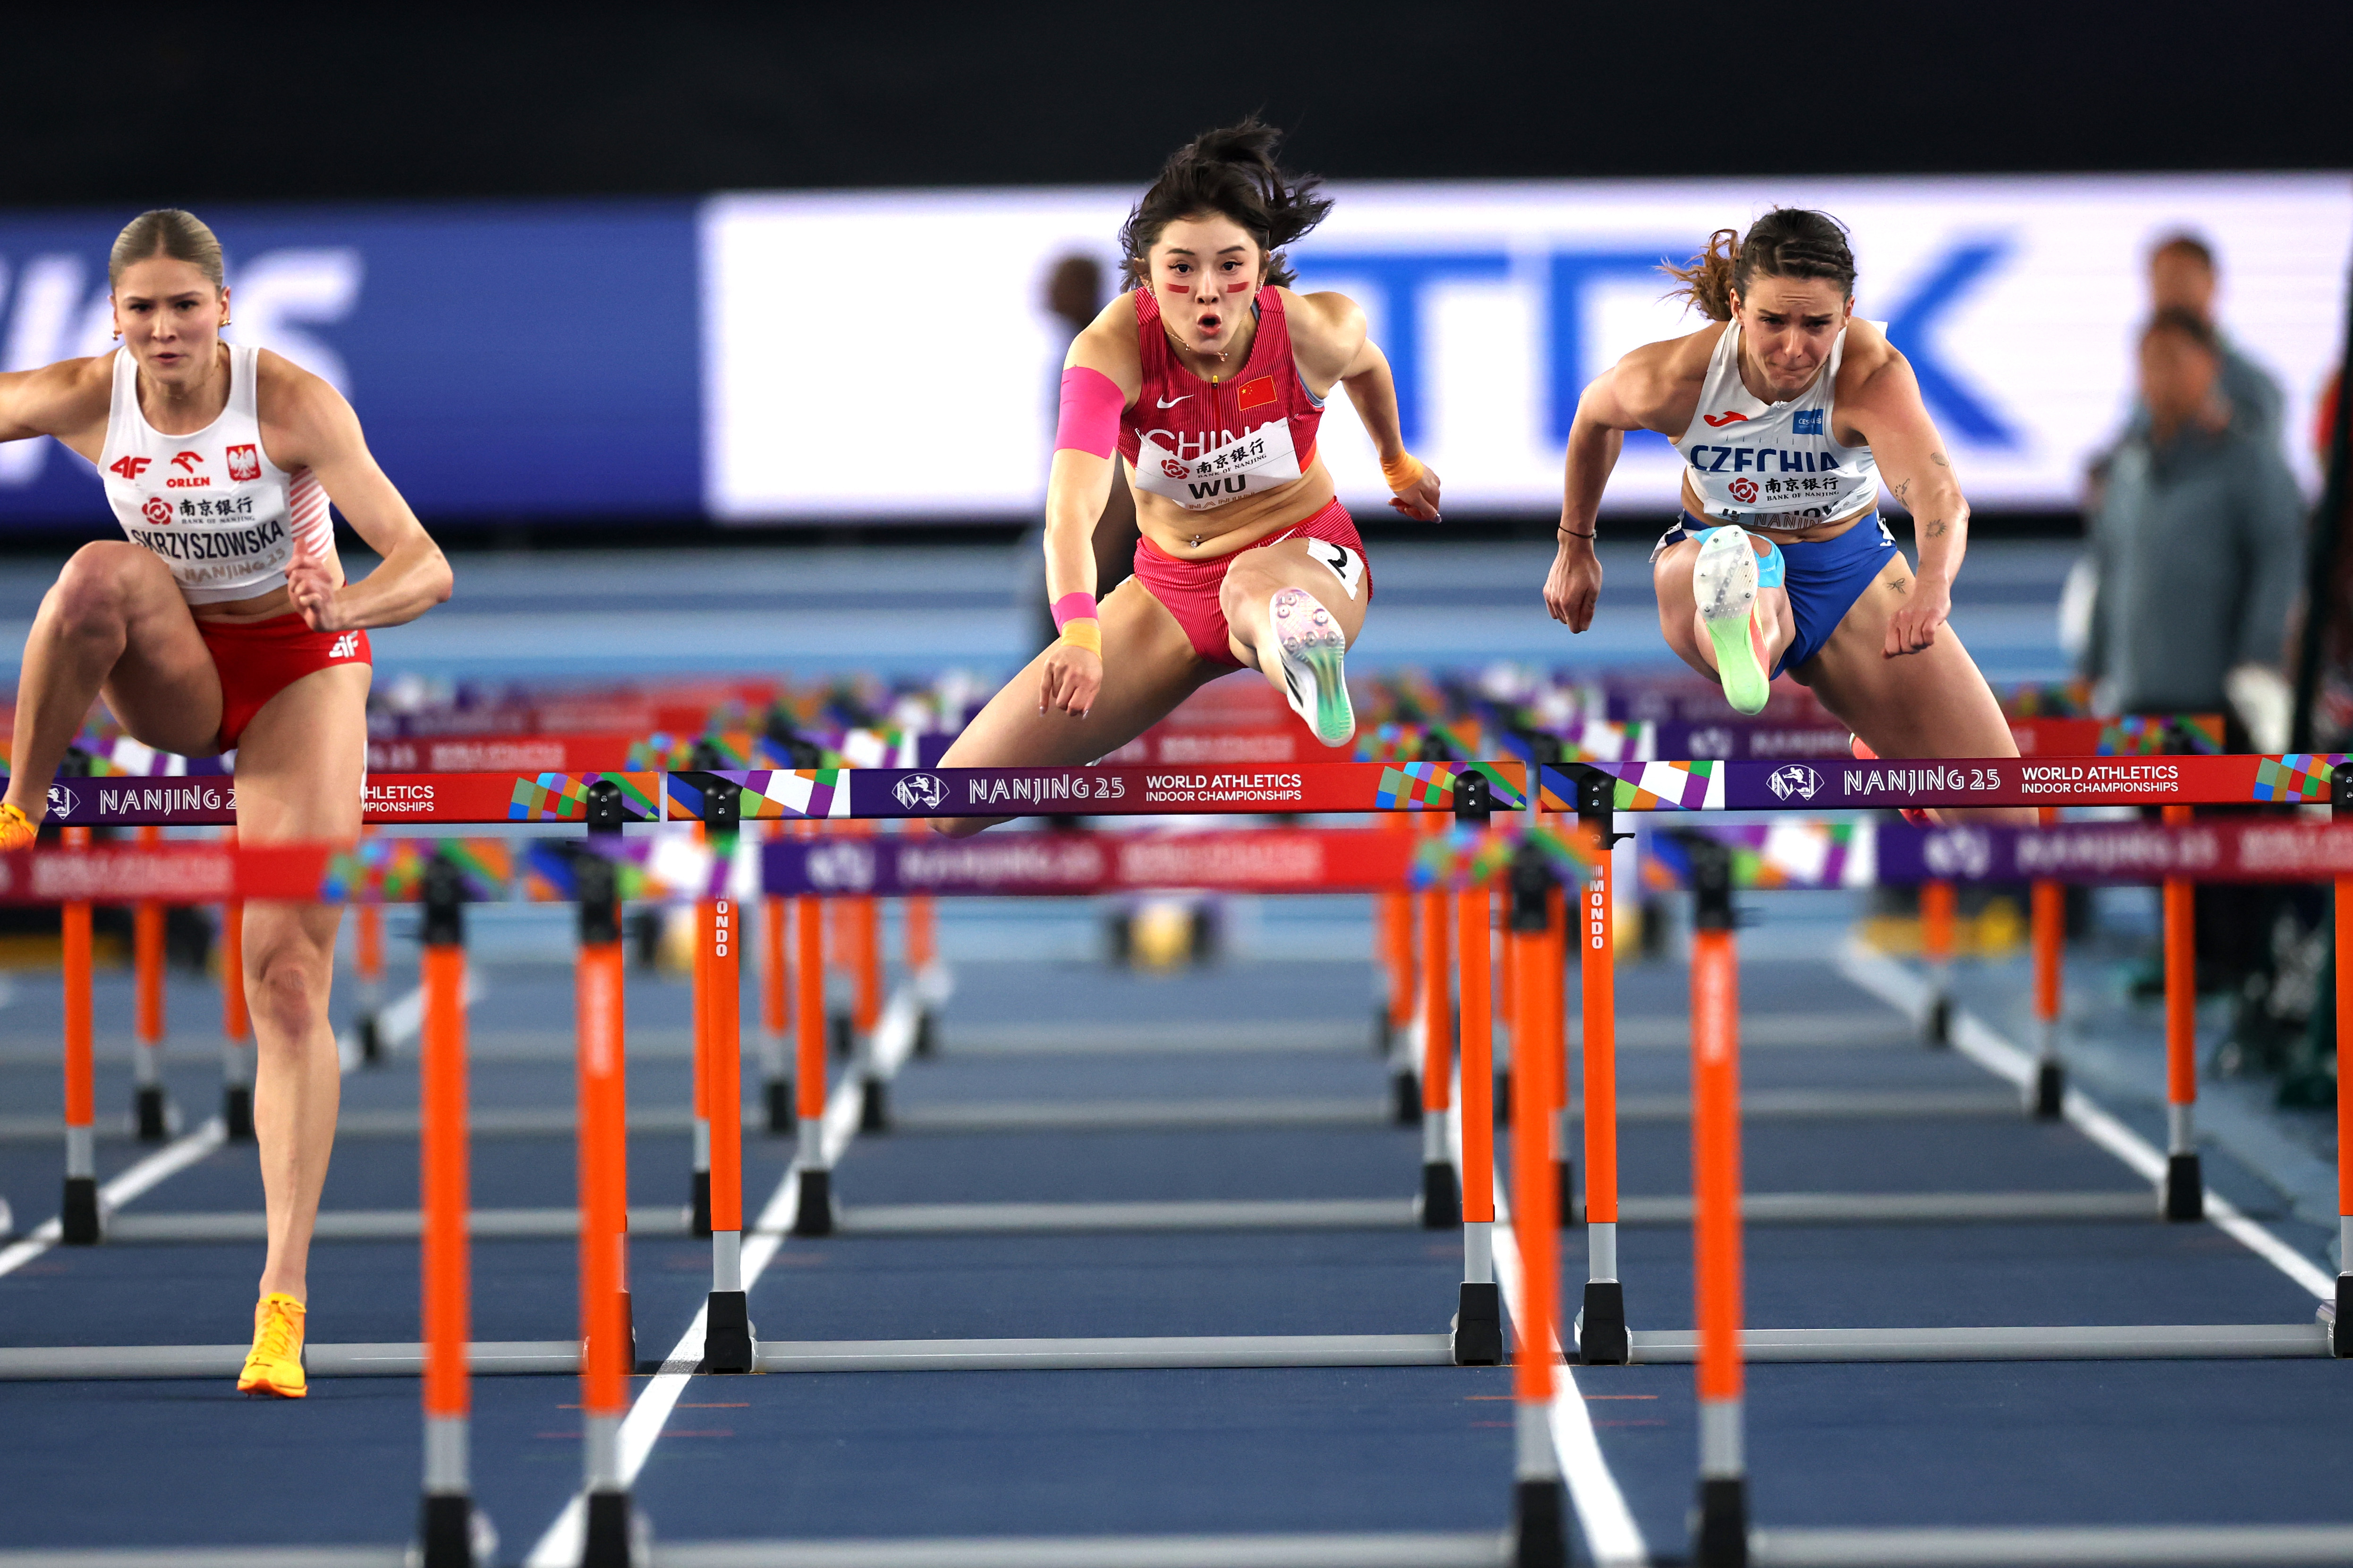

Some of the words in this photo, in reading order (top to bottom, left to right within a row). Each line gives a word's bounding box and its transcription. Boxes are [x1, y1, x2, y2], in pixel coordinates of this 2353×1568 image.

[1145, 421, 1274, 461] CHIN
[110, 456, 152, 480] 4F
[1196, 438, 1265, 474] 南京银行
[1234, 453, 1267, 469] NANJING
[1690, 445, 1840, 472] CZECHIA
[166, 476, 210, 488] ORLEN
[1188, 474, 1246, 500] WU
[1765, 477, 1839, 493] 南京银行
[179, 496, 253, 517] 南京银行
[1767, 493, 1789, 501] BANK
[131, 520, 284, 560] SKRZYSZOWSKA
[329, 630, 359, 658] 4F
[1146, 775, 1206, 789] WORLD
[1211, 774, 1301, 788] ATHLETICS
[1844, 765, 1964, 797] NANJING
[1970, 769, 2001, 790] 25
[2022, 767, 2083, 780] WORLD
[2087, 765, 2179, 780] ATHLETICS
[365, 785, 434, 799] HLETICS
[969, 773, 1089, 805] NANJING
[1095, 777, 1125, 799] 25
[1146, 791, 1195, 801] INDOOR
[1198, 790, 1301, 801] CHAMPIONSHIPS
[2022, 783, 2071, 793] INDOOR
[2073, 782, 2179, 793] CHAMPIONSHIPS
[100, 785, 221, 816] NANJING
[226, 788, 237, 810] 2
[1589, 880, 1604, 949] MONDO
